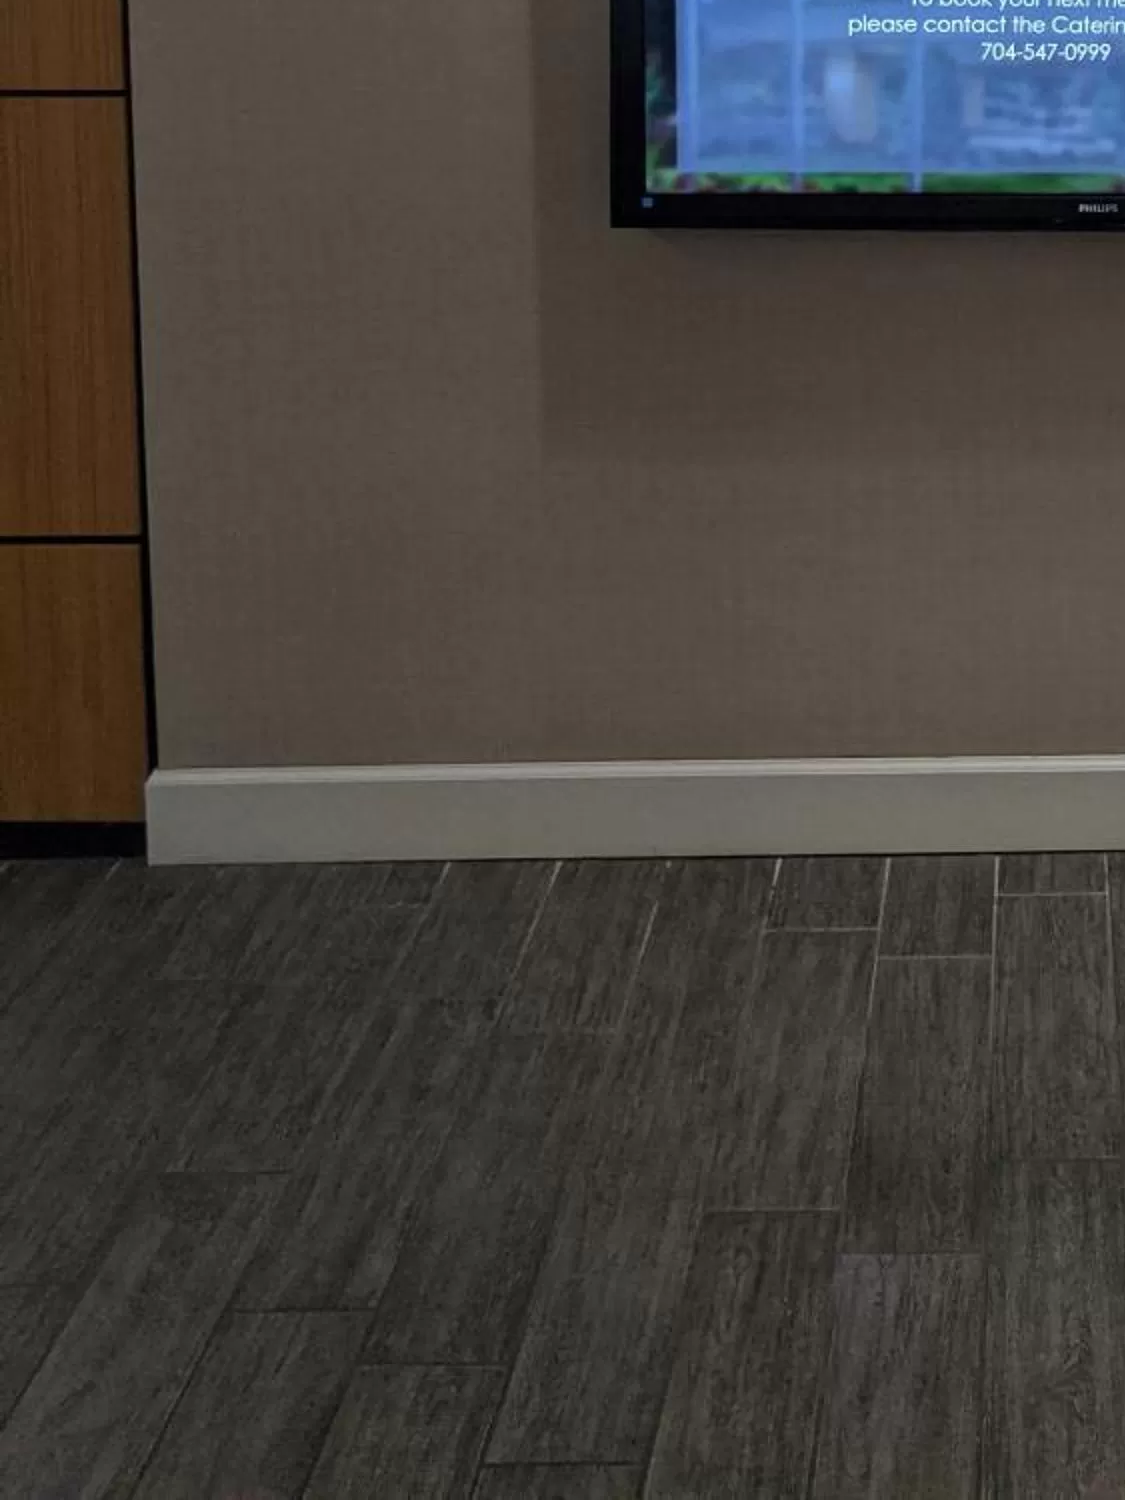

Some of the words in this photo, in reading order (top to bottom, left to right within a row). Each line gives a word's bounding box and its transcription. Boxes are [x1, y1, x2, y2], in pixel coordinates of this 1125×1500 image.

[848, 15, 917, 36] please
[923, 15, 1006, 33] contact
[1013, 16, 1046, 34] the
[981, 43, 1111, 61] 704-547-0999
